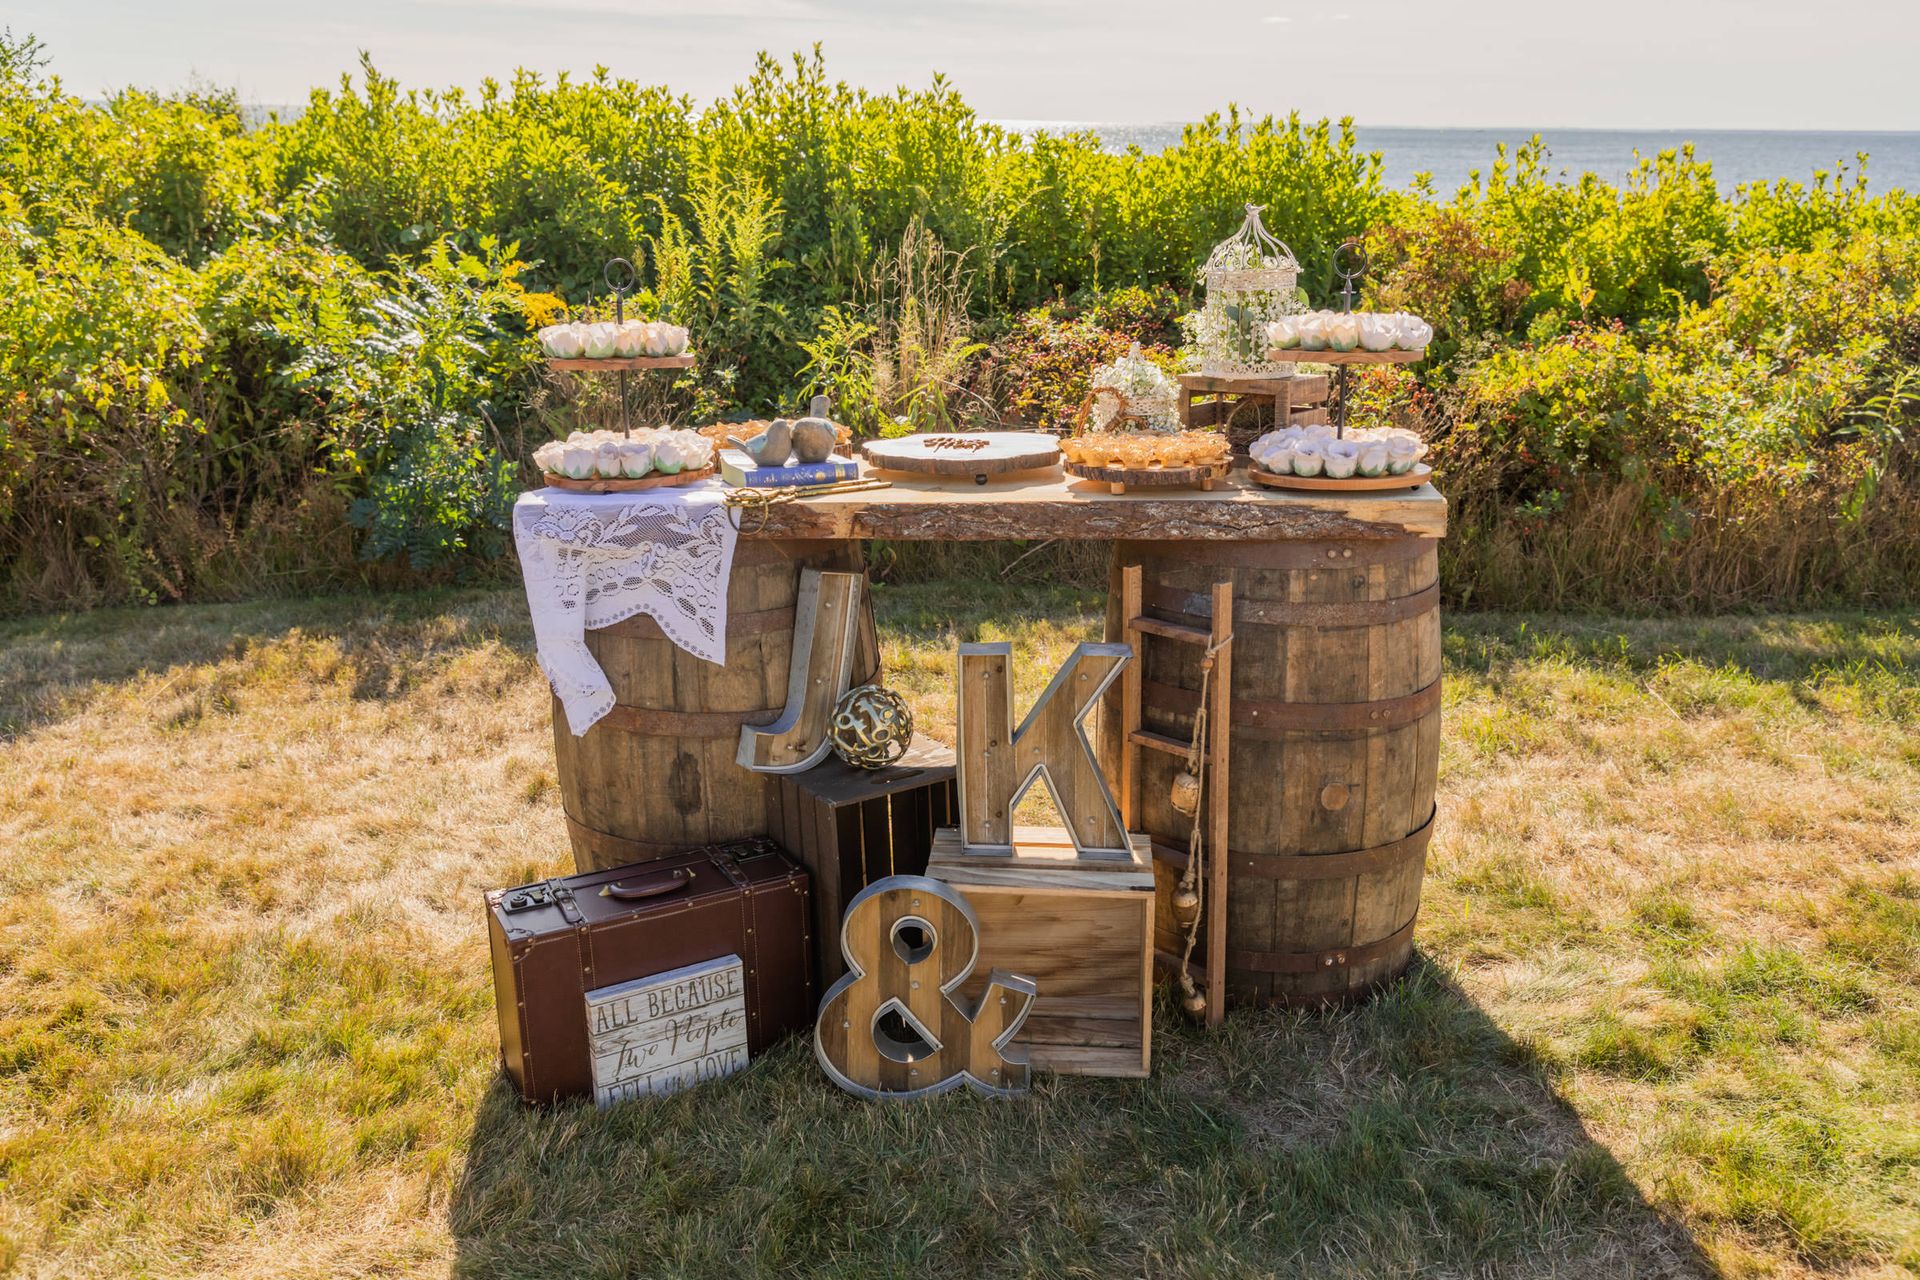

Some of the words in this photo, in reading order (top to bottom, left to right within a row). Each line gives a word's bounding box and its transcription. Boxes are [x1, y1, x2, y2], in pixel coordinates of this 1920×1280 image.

[957, 641, 1134, 862] K
[597, 998, 638, 1032] ALL
[647, 969, 741, 1017] BECAUSE
[600, 1036, 658, 1077] Two
[665, 1008, 744, 1057] People
